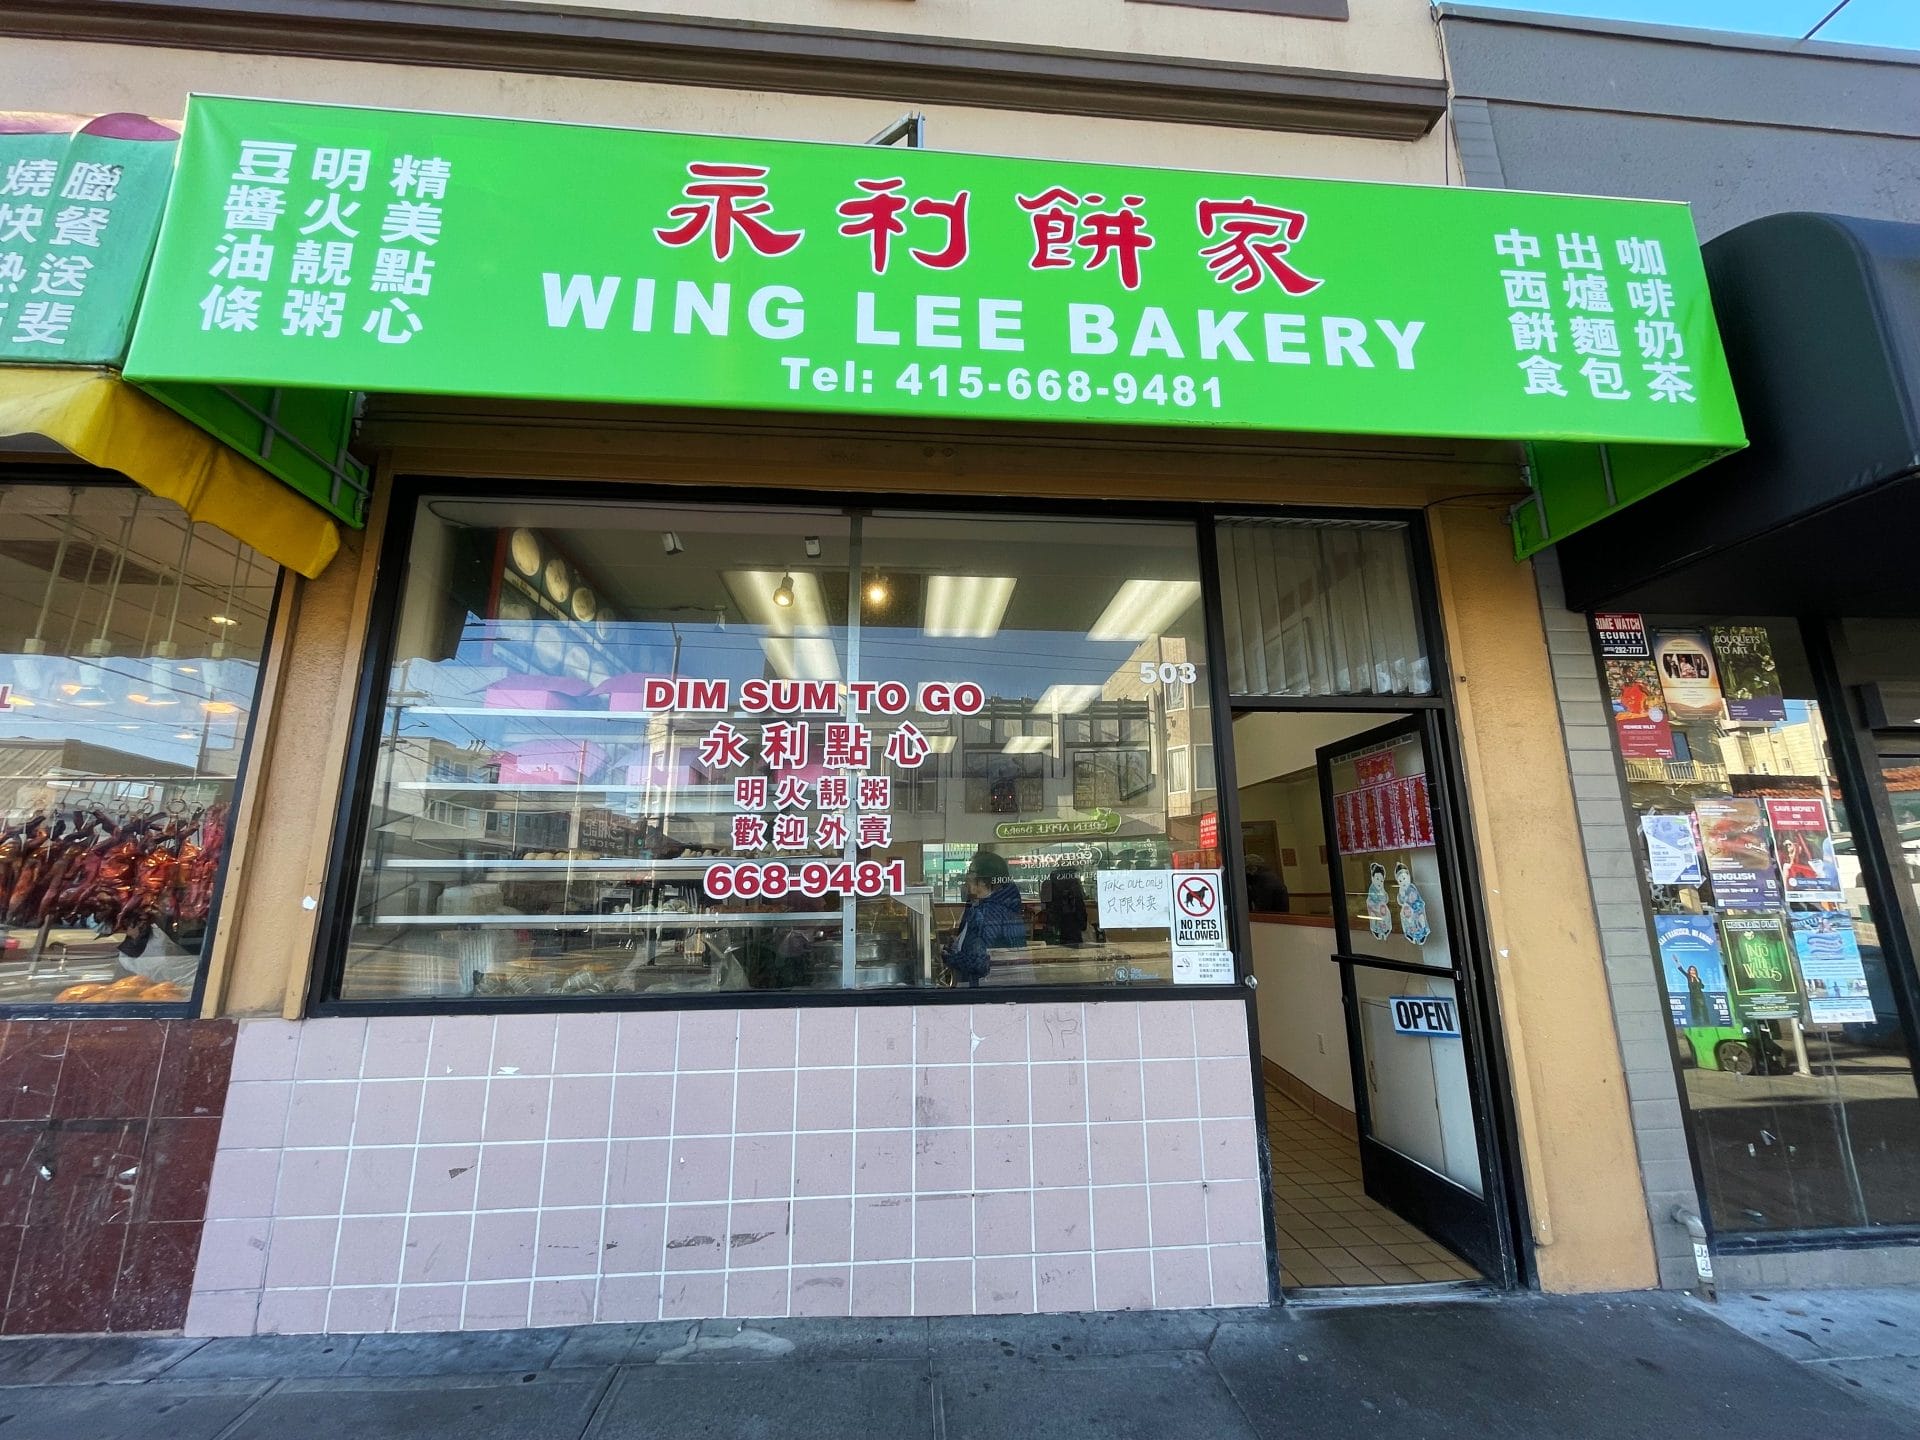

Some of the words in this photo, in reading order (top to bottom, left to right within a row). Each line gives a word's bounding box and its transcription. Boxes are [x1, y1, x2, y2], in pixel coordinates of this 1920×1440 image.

[281, 148, 371, 338] 明火靚粥
[652, 161, 1325, 297] 永利餅家
[362, 155, 452, 344] 精美點心
[542, 272, 805, 340] WING
[856, 291, 1024, 351] LEE
[1068, 303, 1426, 370] BAKERY
[1494, 228, 1569, 397] 中西餅食
[1615, 237, 1697, 403] 咖啡奶茶
[781, 357, 873, 394] Tel:
[896, 363, 1222, 408] 415-668-9481
[1614, 617, 1641, 630] WATCH
[1714, 635, 1760, 646] BOUQUETS
[1717, 646, 1730, 654] TO
[1732, 646, 1749, 655] ART
[1140, 662, 1197, 684] 503
[643, 678, 729, 713] DIM
[740, 680, 839, 714] SUM
[848, 681, 909, 715] TO
[920, 681, 985, 716] GO
[699, 721, 931, 770] 永利點心
[734, 776, 891, 811] 明火靚粥
[732, 814, 893, 850] 歡迎外賣
[704, 859, 906, 899] 668-9481
[1104, 879, 1125, 891] Take
[1127, 879, 1144, 889] out
[1145, 876, 1163, 889] only
[1712, 872, 1756, 881] ENGLISH
[1178, 930, 1220, 941] ALLOWED
[1180, 919, 1193, 930] NO
[1195, 919, 1217, 930] PETS
[1742, 963, 1783, 982] WOODS
[1396, 1000, 1454, 1031] OPEN
